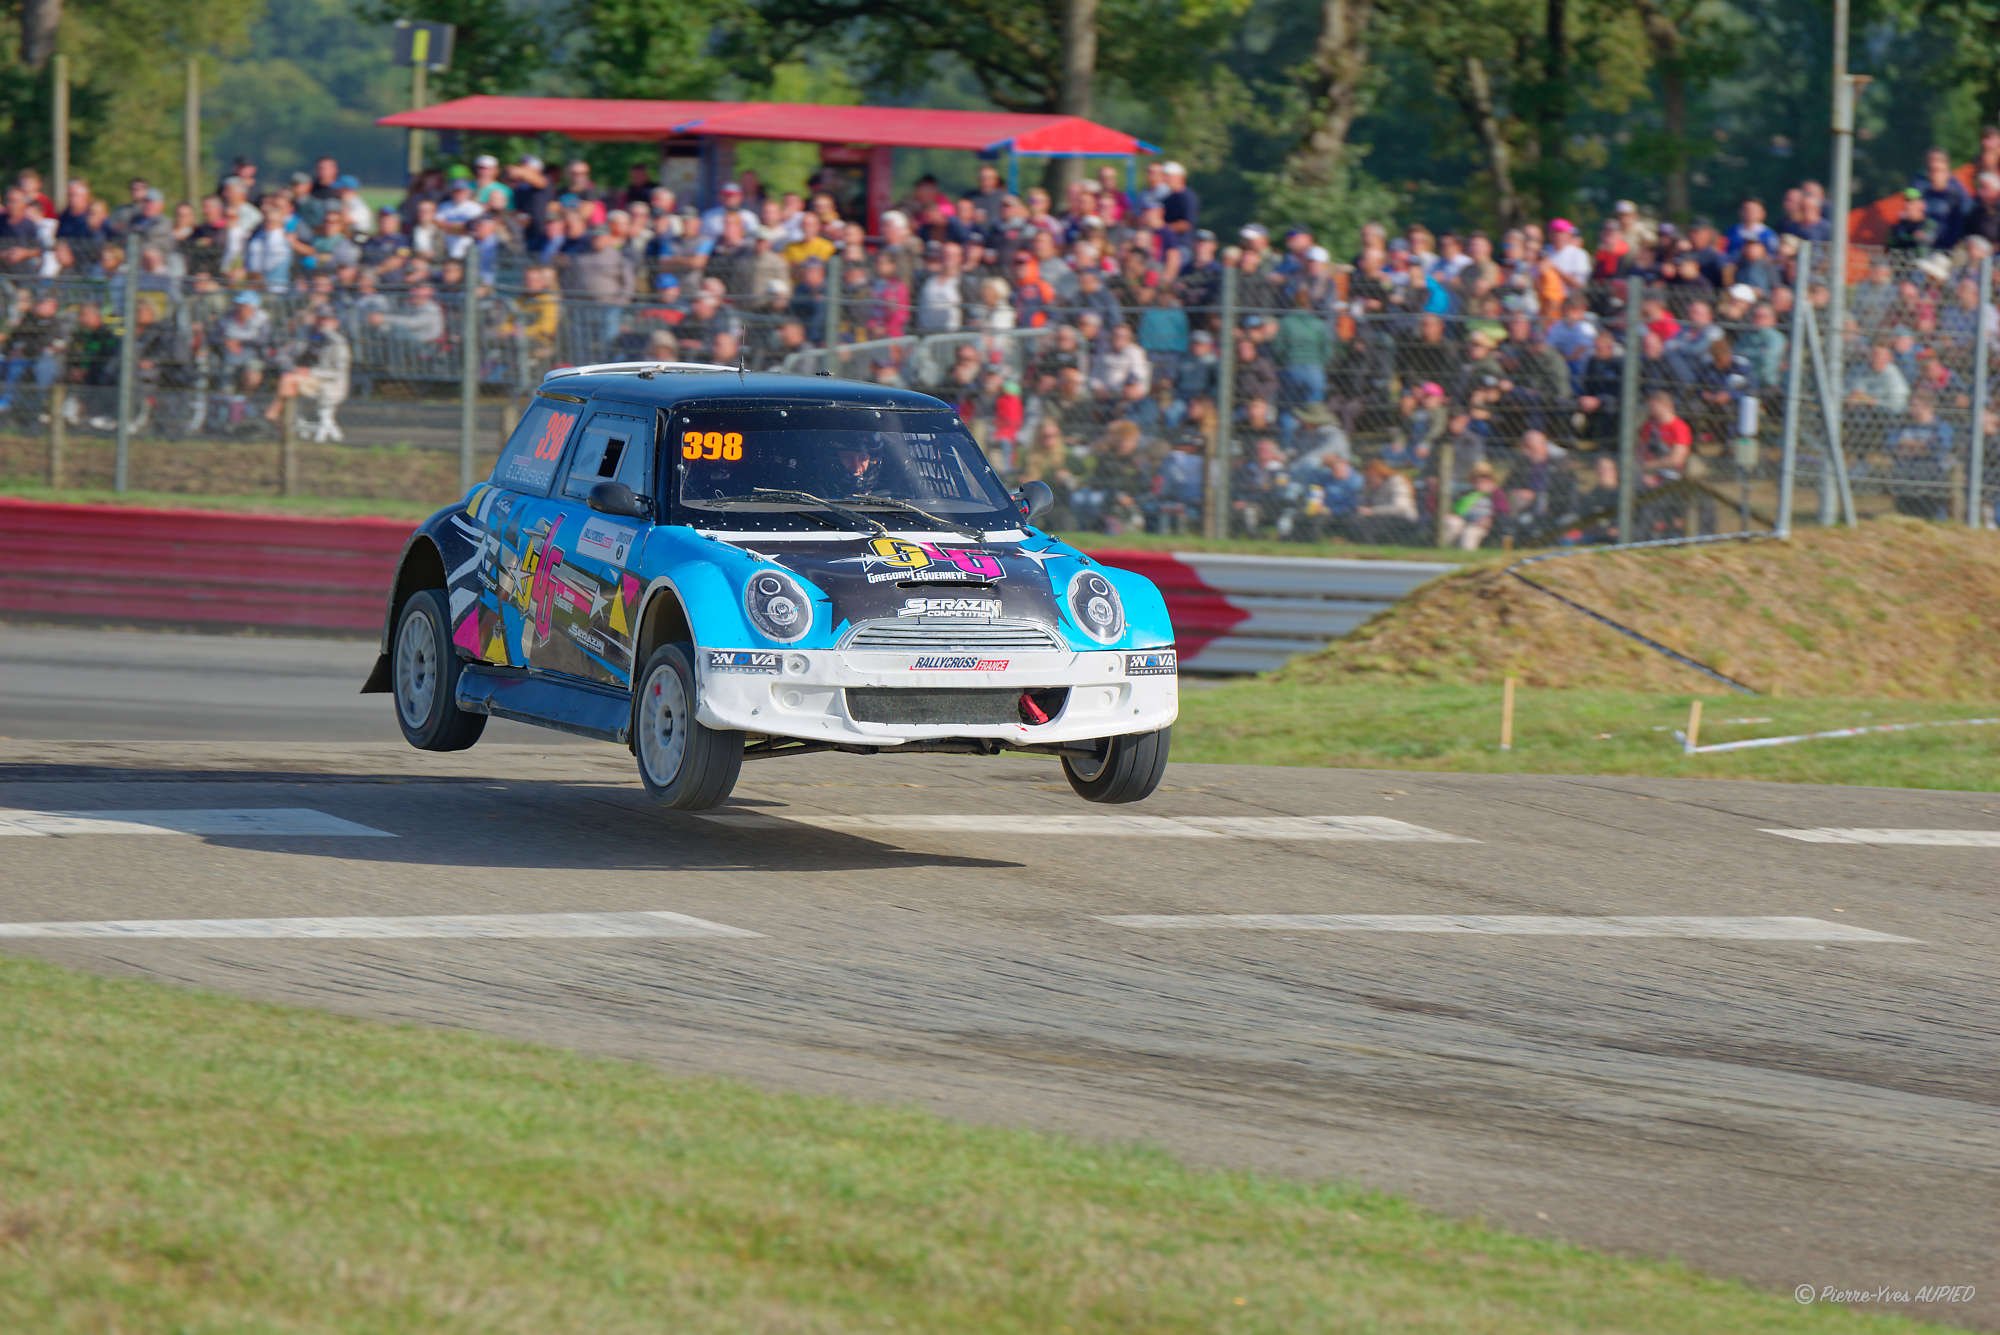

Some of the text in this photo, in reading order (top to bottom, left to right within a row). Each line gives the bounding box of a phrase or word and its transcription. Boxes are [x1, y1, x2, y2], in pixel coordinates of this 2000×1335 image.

[682, 431, 743, 460] 398
[867, 571, 910, 583] GREGORY
[897, 598, 1002, 618] SERAZIN
[914, 657, 1008, 671] RALLYCROSS FRANCE
